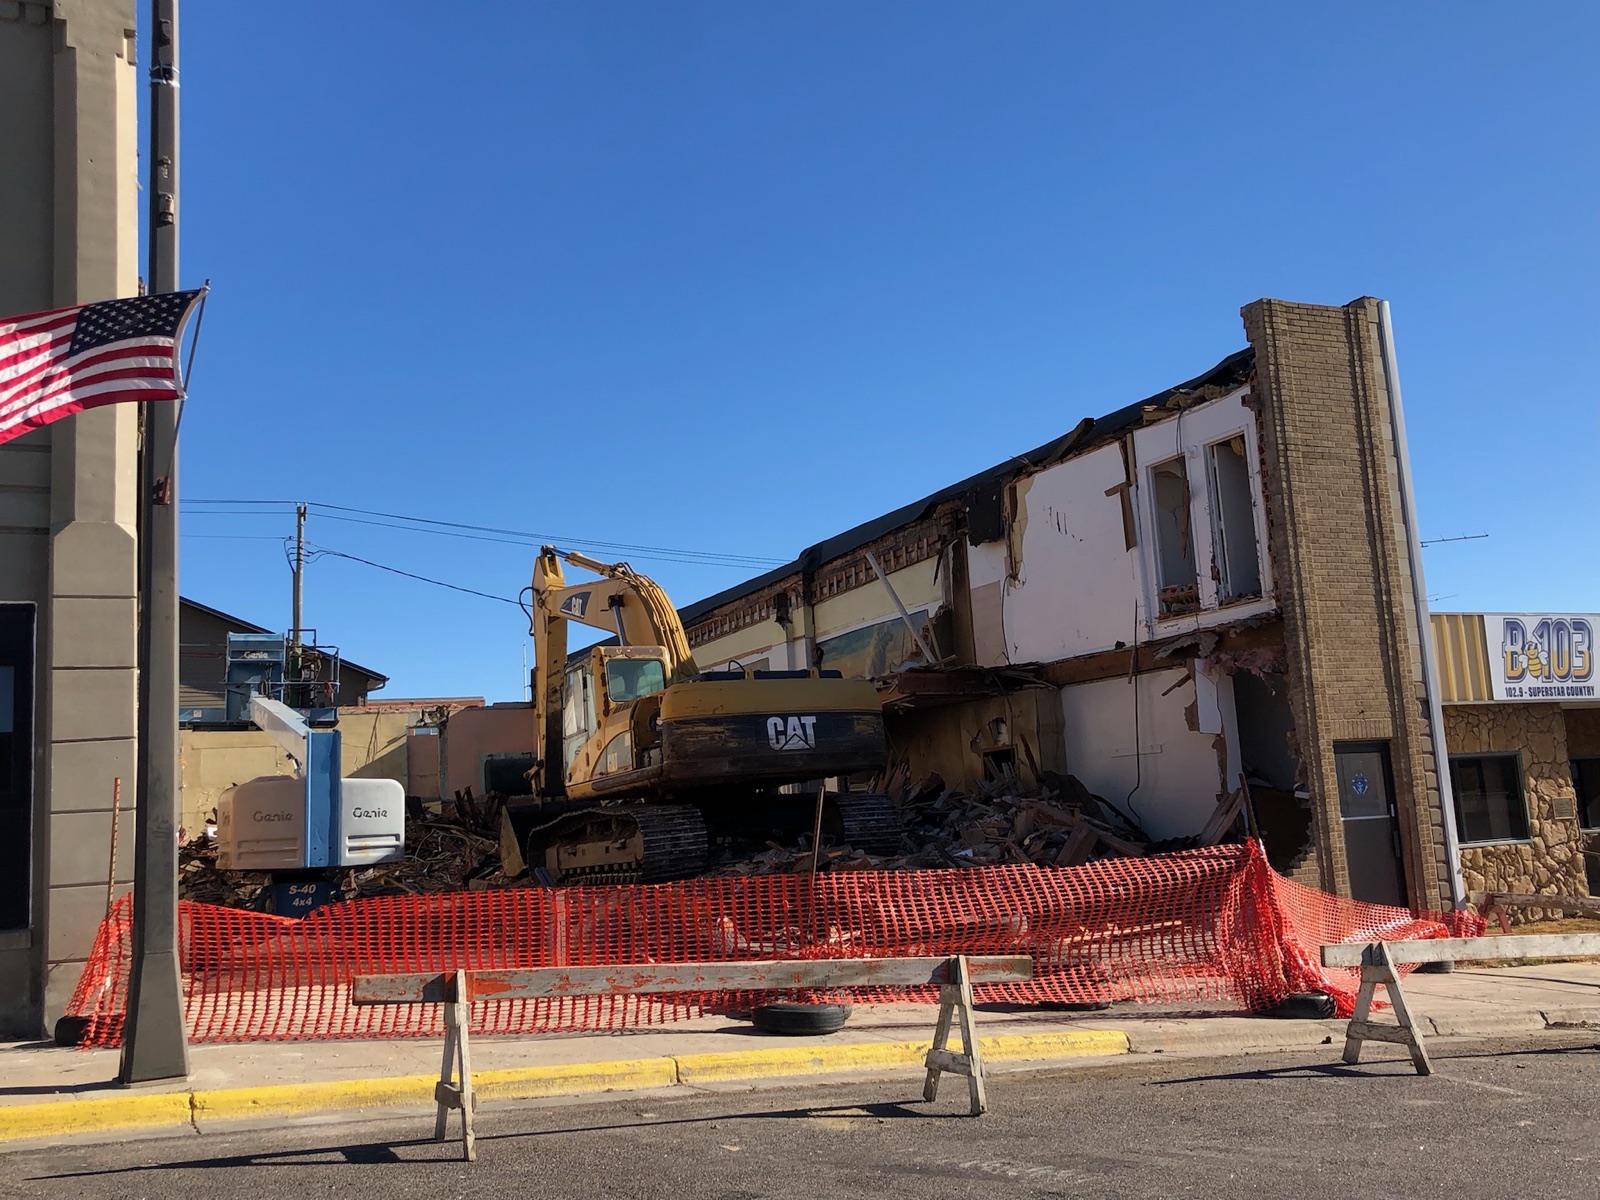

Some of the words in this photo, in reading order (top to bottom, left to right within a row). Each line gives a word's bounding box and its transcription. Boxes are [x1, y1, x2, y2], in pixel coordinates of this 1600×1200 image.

[571, 596, 582, 616] CAT
[243, 651, 269, 659] Genie
[1528, 687, 1566, 697] SUPERSTAR
[1566, 686, 1595, 697] COUNTRY
[766, 715, 817, 750] CAT
[252, 810, 294, 823] Genie
[352, 807, 388, 819] Genie
[288, 884, 317, 895] S-40
[292, 897, 313, 907] 4x4
